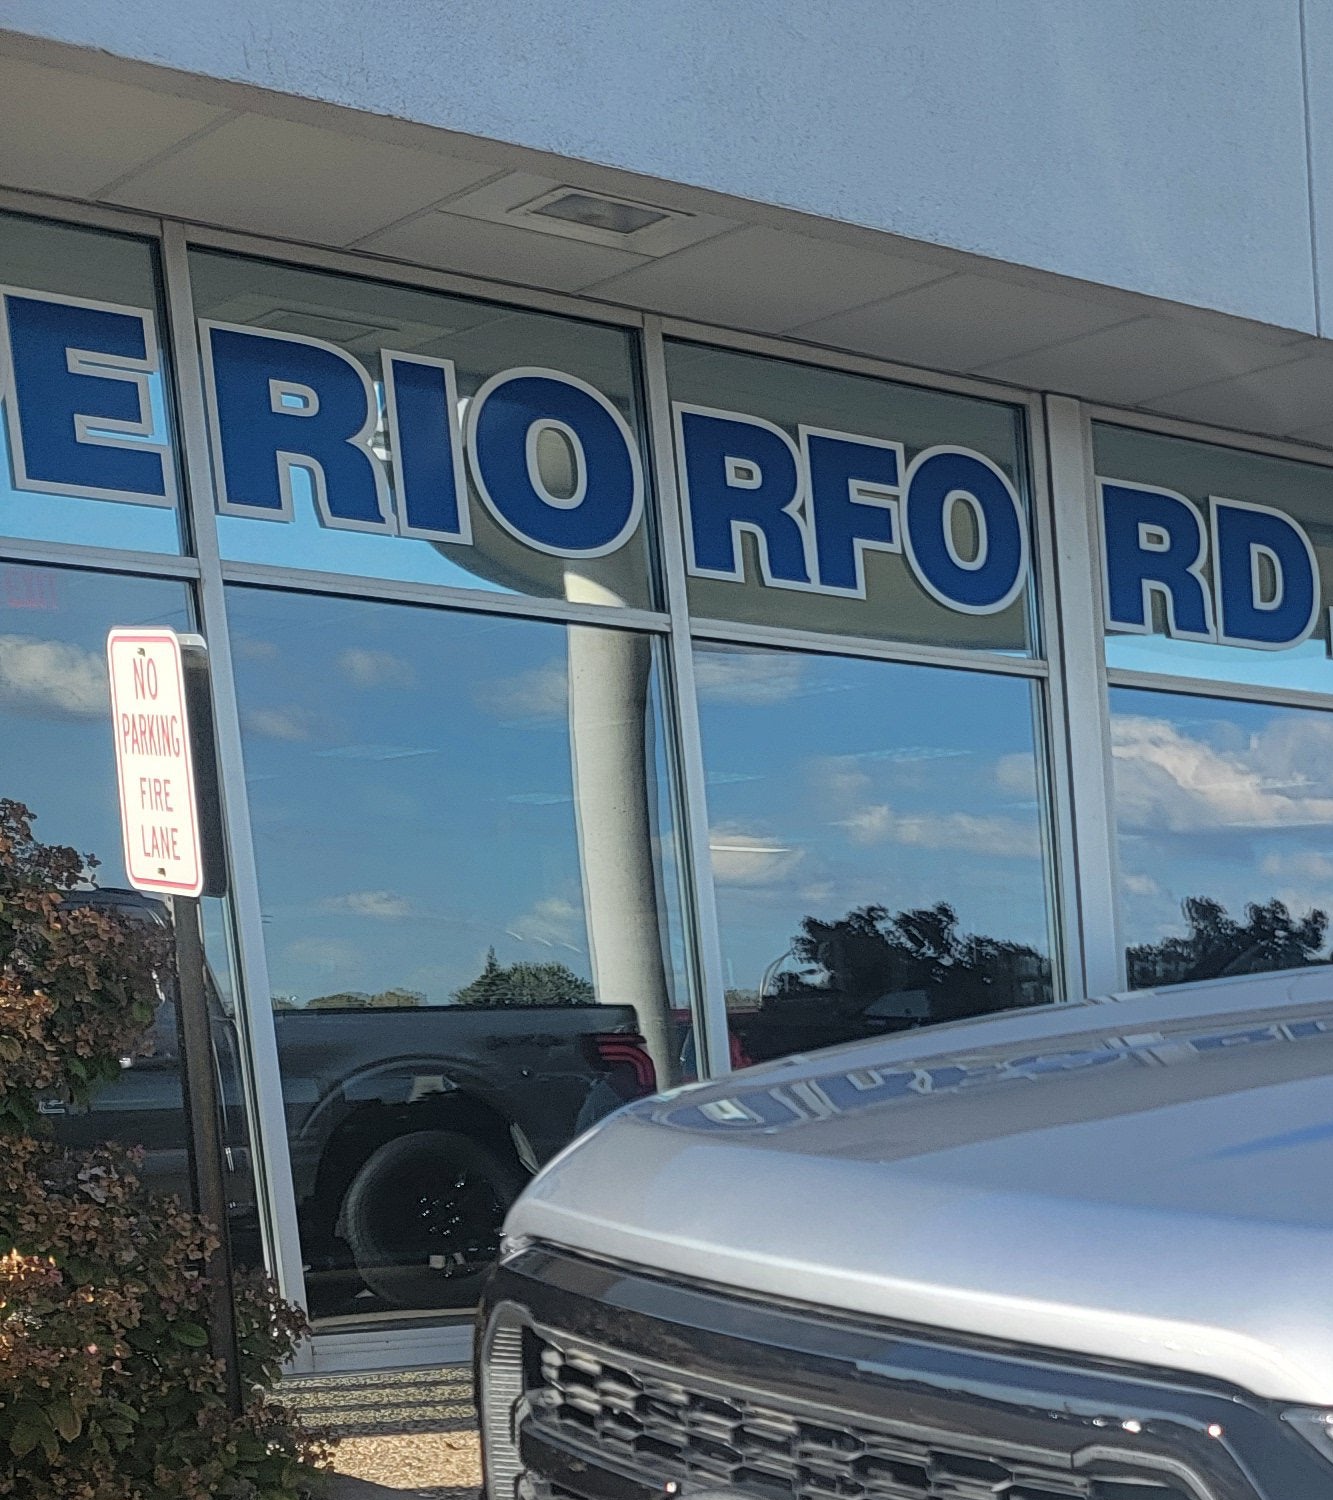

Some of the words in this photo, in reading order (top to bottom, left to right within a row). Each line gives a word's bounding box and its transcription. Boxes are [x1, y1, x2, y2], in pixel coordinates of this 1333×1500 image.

[132, 658, 158, 700] NO
[121, 713, 180, 757] PARKING
[139, 777, 173, 812] FIRE
[141, 824, 180, 860] LANE
